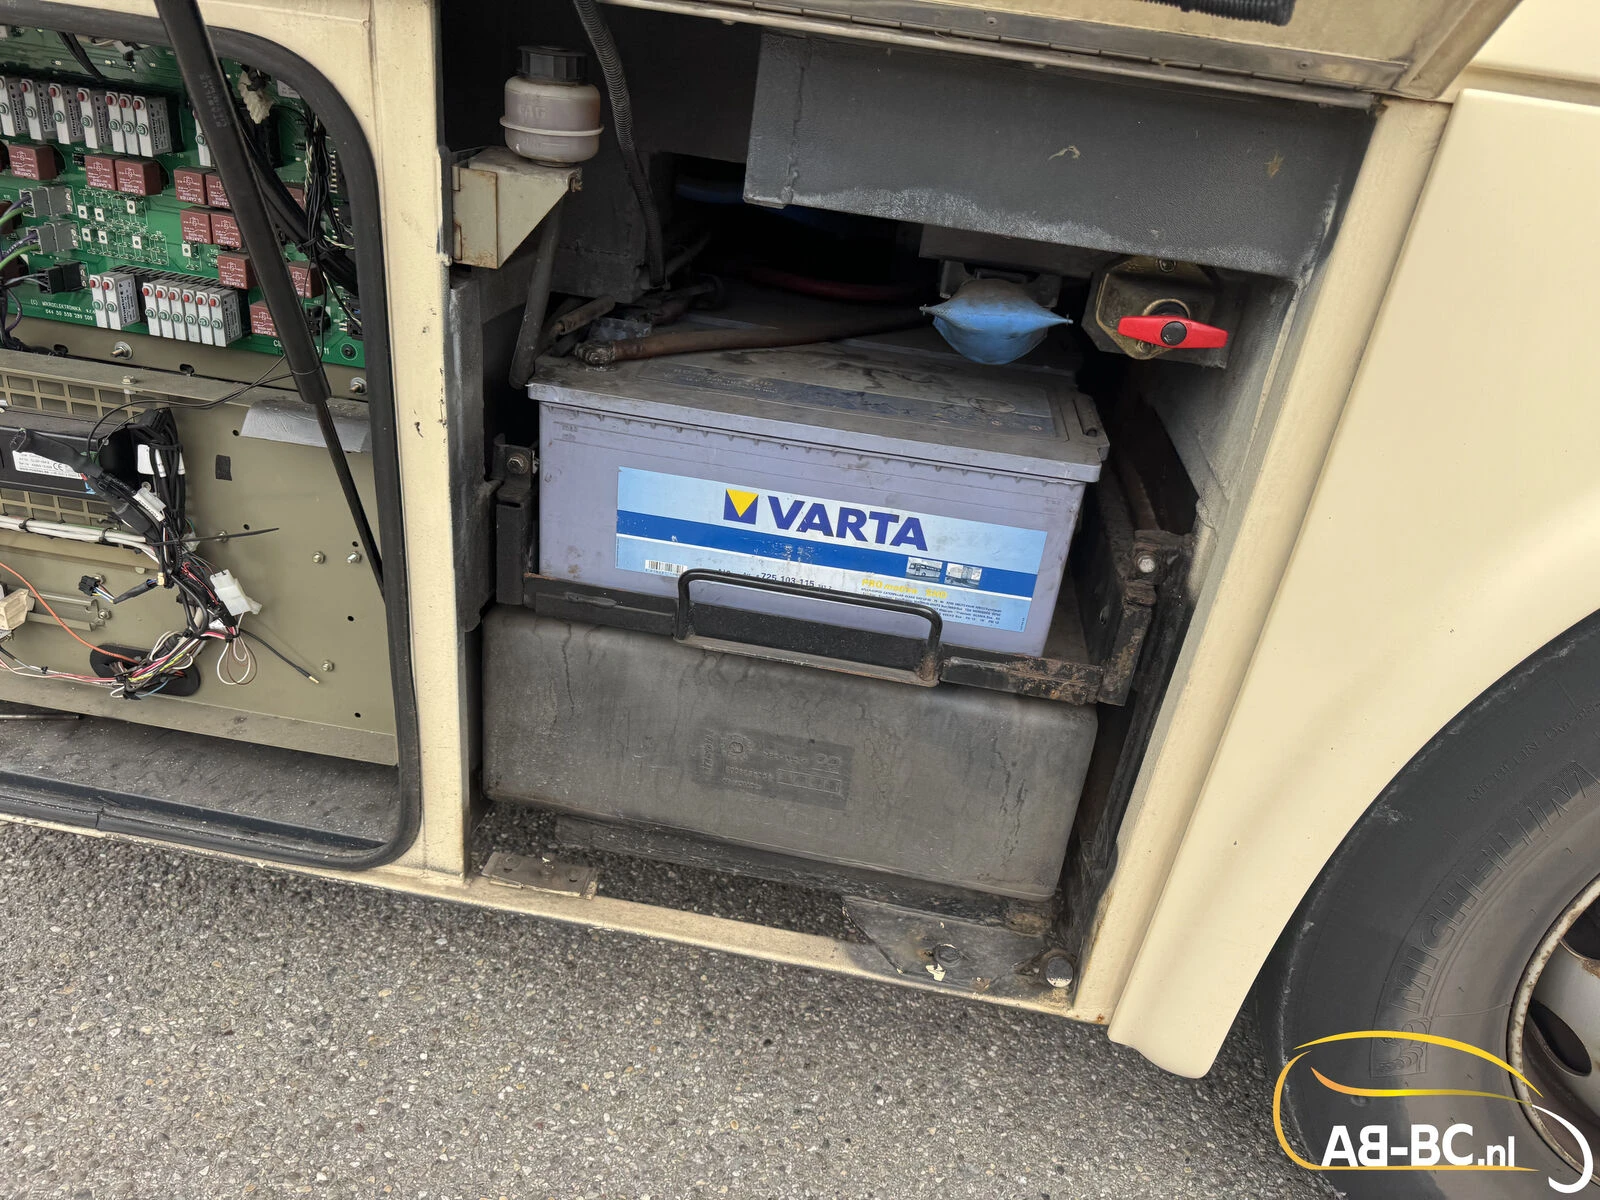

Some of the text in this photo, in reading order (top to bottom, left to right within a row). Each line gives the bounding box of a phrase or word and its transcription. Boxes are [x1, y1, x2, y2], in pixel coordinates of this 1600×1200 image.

[767, 495, 928, 551] VARTA
[760, 572, 777, 581] 725
[781, 575, 796, 584] 103
[799, 578, 815, 587] 115
[1388, 770, 1587, 1015] MICHELIN
